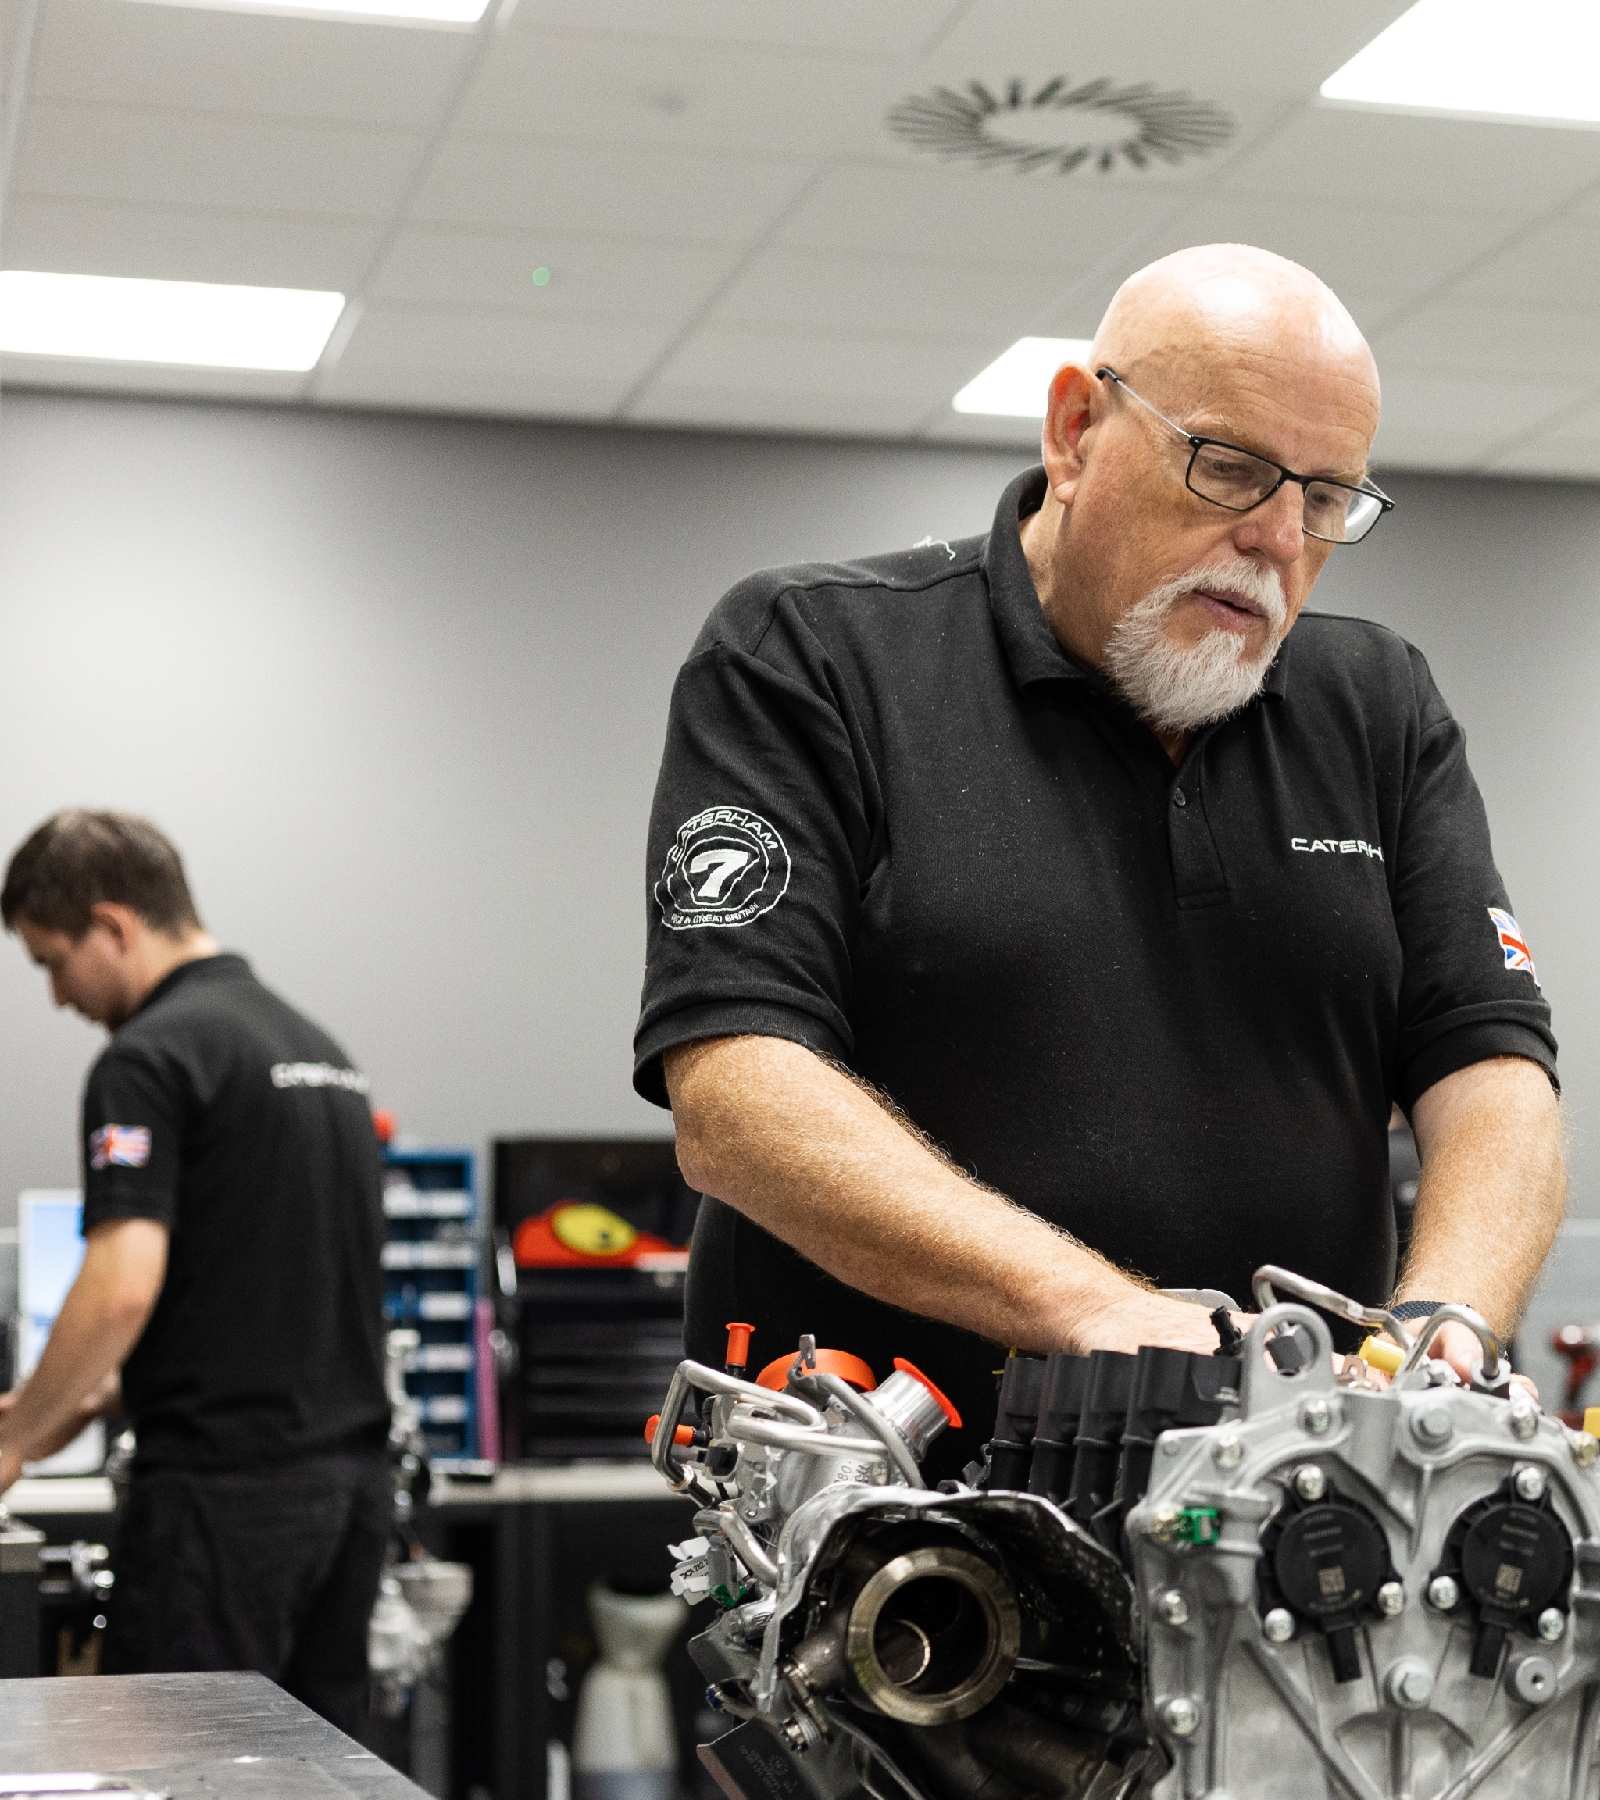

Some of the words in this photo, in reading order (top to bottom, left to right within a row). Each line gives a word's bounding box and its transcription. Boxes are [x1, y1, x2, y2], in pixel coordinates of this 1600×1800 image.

[671, 810, 778, 862] CATERHAM
[1290, 837, 1385, 862] CATERH
[690, 849, 749, 898] 7
